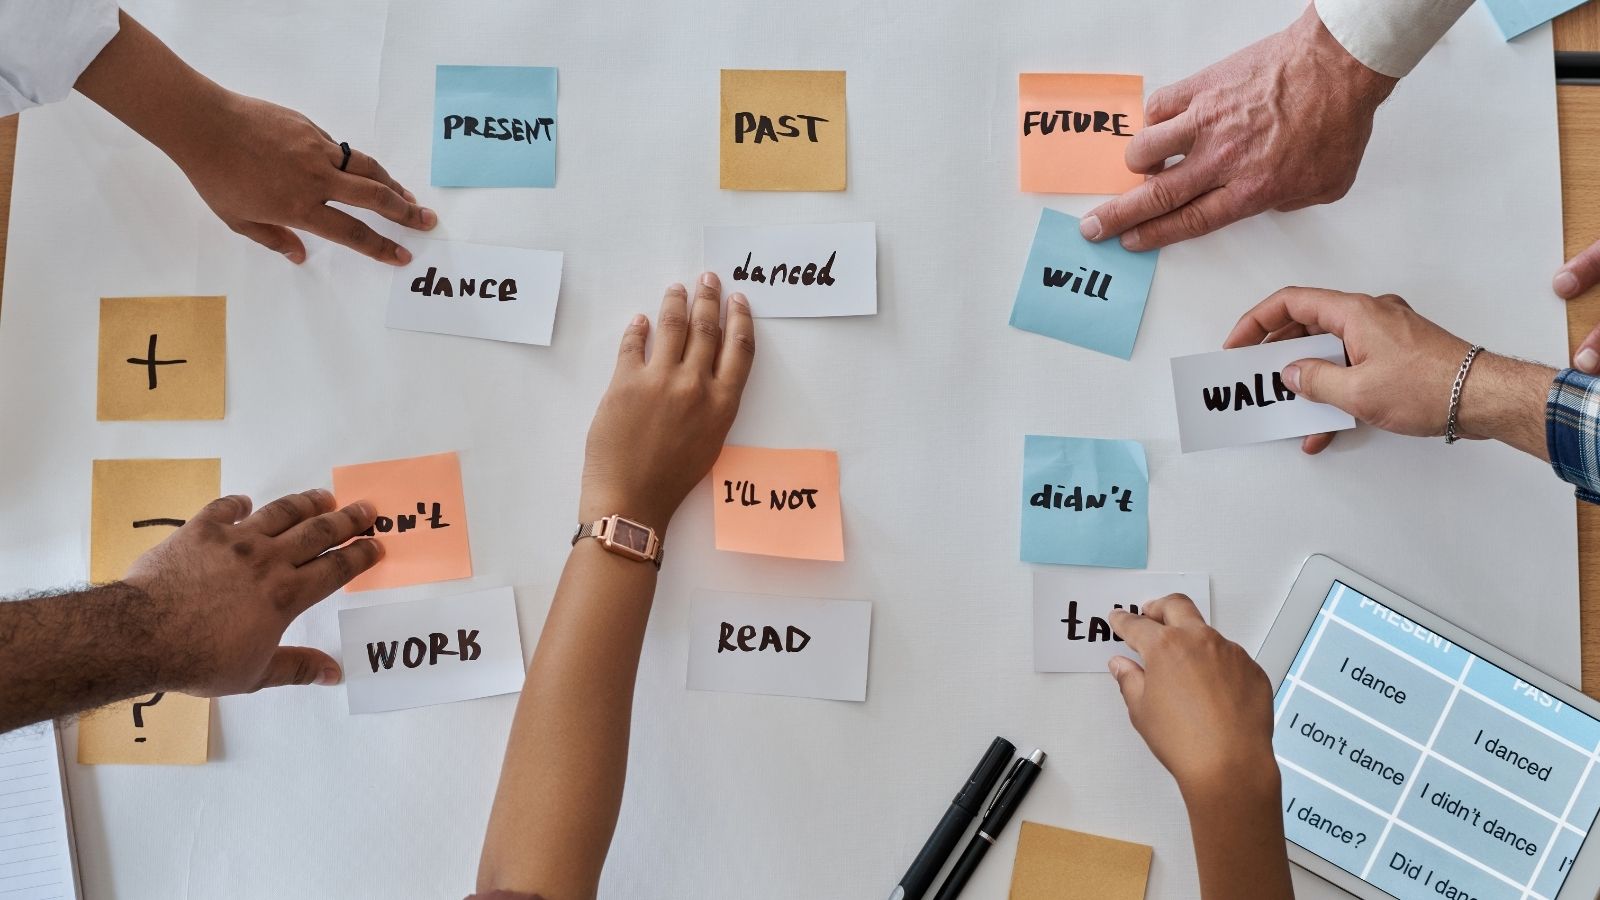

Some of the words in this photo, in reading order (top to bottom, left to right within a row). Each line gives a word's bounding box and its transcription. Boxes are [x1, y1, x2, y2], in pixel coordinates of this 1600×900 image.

[443, 114, 554, 145] PRESENT
[734, 111, 829, 144] PAST
[1023, 110, 1134, 137] FUTURE
[732, 250, 837, 287] danced
[1042, 266, 1113, 301] will
[770, 488, 819, 511] NOT
[366, 629, 482, 674] WORK
[1339, 657, 1350, 673] I
[1351, 665, 1407, 705] dance
[1289, 712, 1300, 729] I
[1300, 722, 1348, 755] don't
[1349, 748, 1405, 786] dance
[1473, 729, 1484, 745] I
[1484, 738, 1553, 782] danced
[1286, 797, 1296, 813] I
[1297, 806, 1367, 850] dance?
[1420, 782, 1430, 798] I
[1431, 791, 1481, 827] didn't
[1482, 819, 1538, 857] dance
[1388, 851, 1423, 881] Did
[1424, 870, 1434, 886] I
